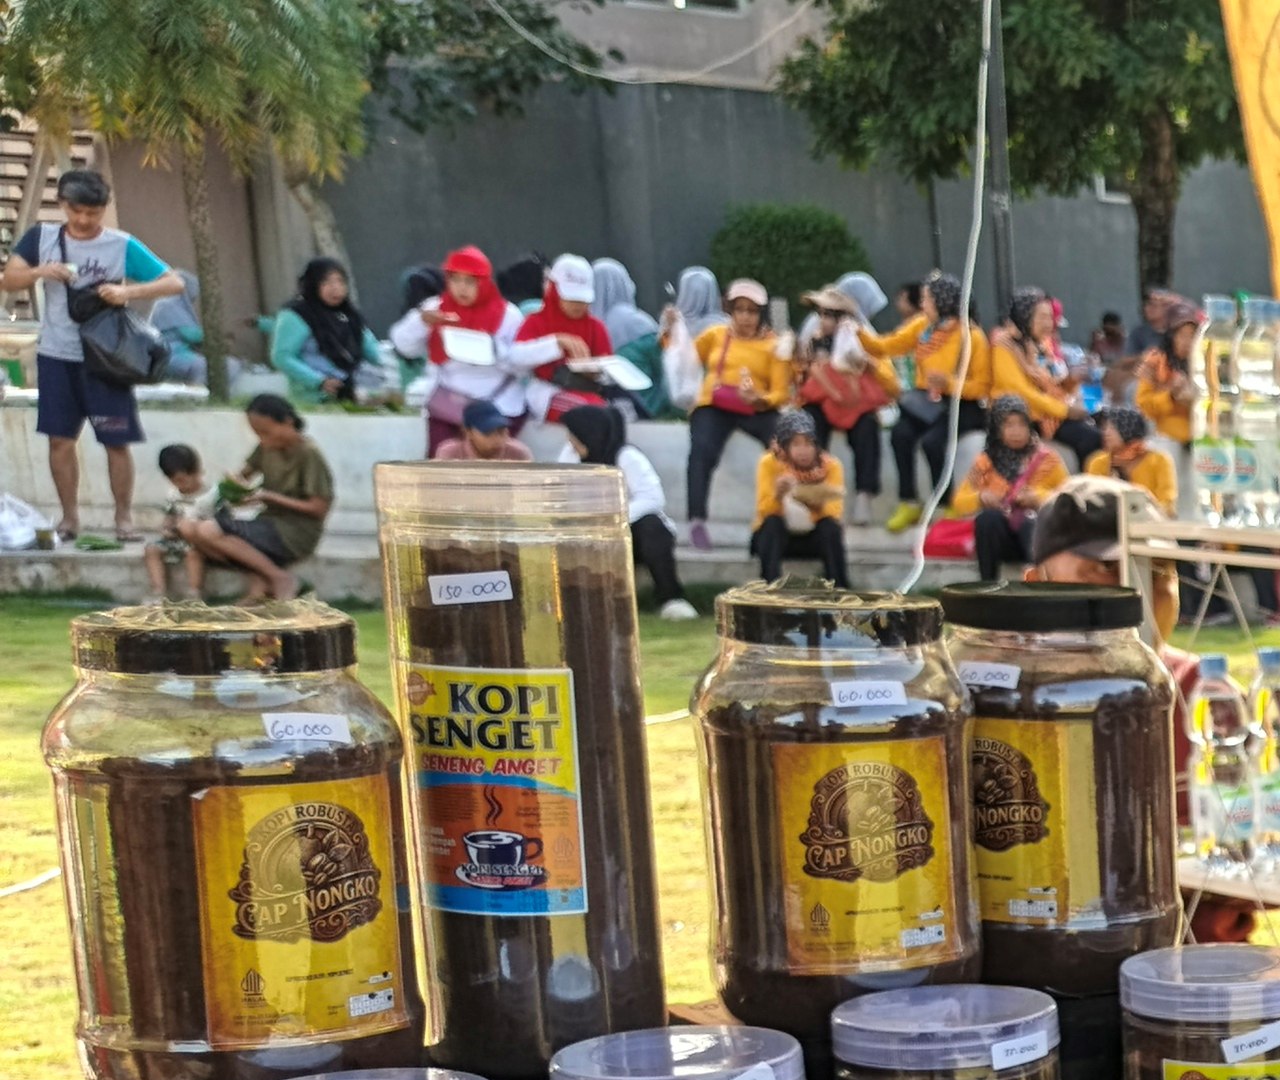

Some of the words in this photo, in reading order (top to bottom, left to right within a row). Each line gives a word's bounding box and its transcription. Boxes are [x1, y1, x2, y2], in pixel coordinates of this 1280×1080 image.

[449, 683, 560, 715] KOPI
[410, 715, 560, 750] SENGET
[421, 753, 486, 775] SENENG
[492, 758, 563, 776] ANGET
[975, 804, 1043, 832] NONGKO
[807, 845, 847, 872] CAP
[851, 825, 928, 866] NONGKO
[237, 901, 288, 932] CAP
[293, 875, 376, 923] NONGKO
